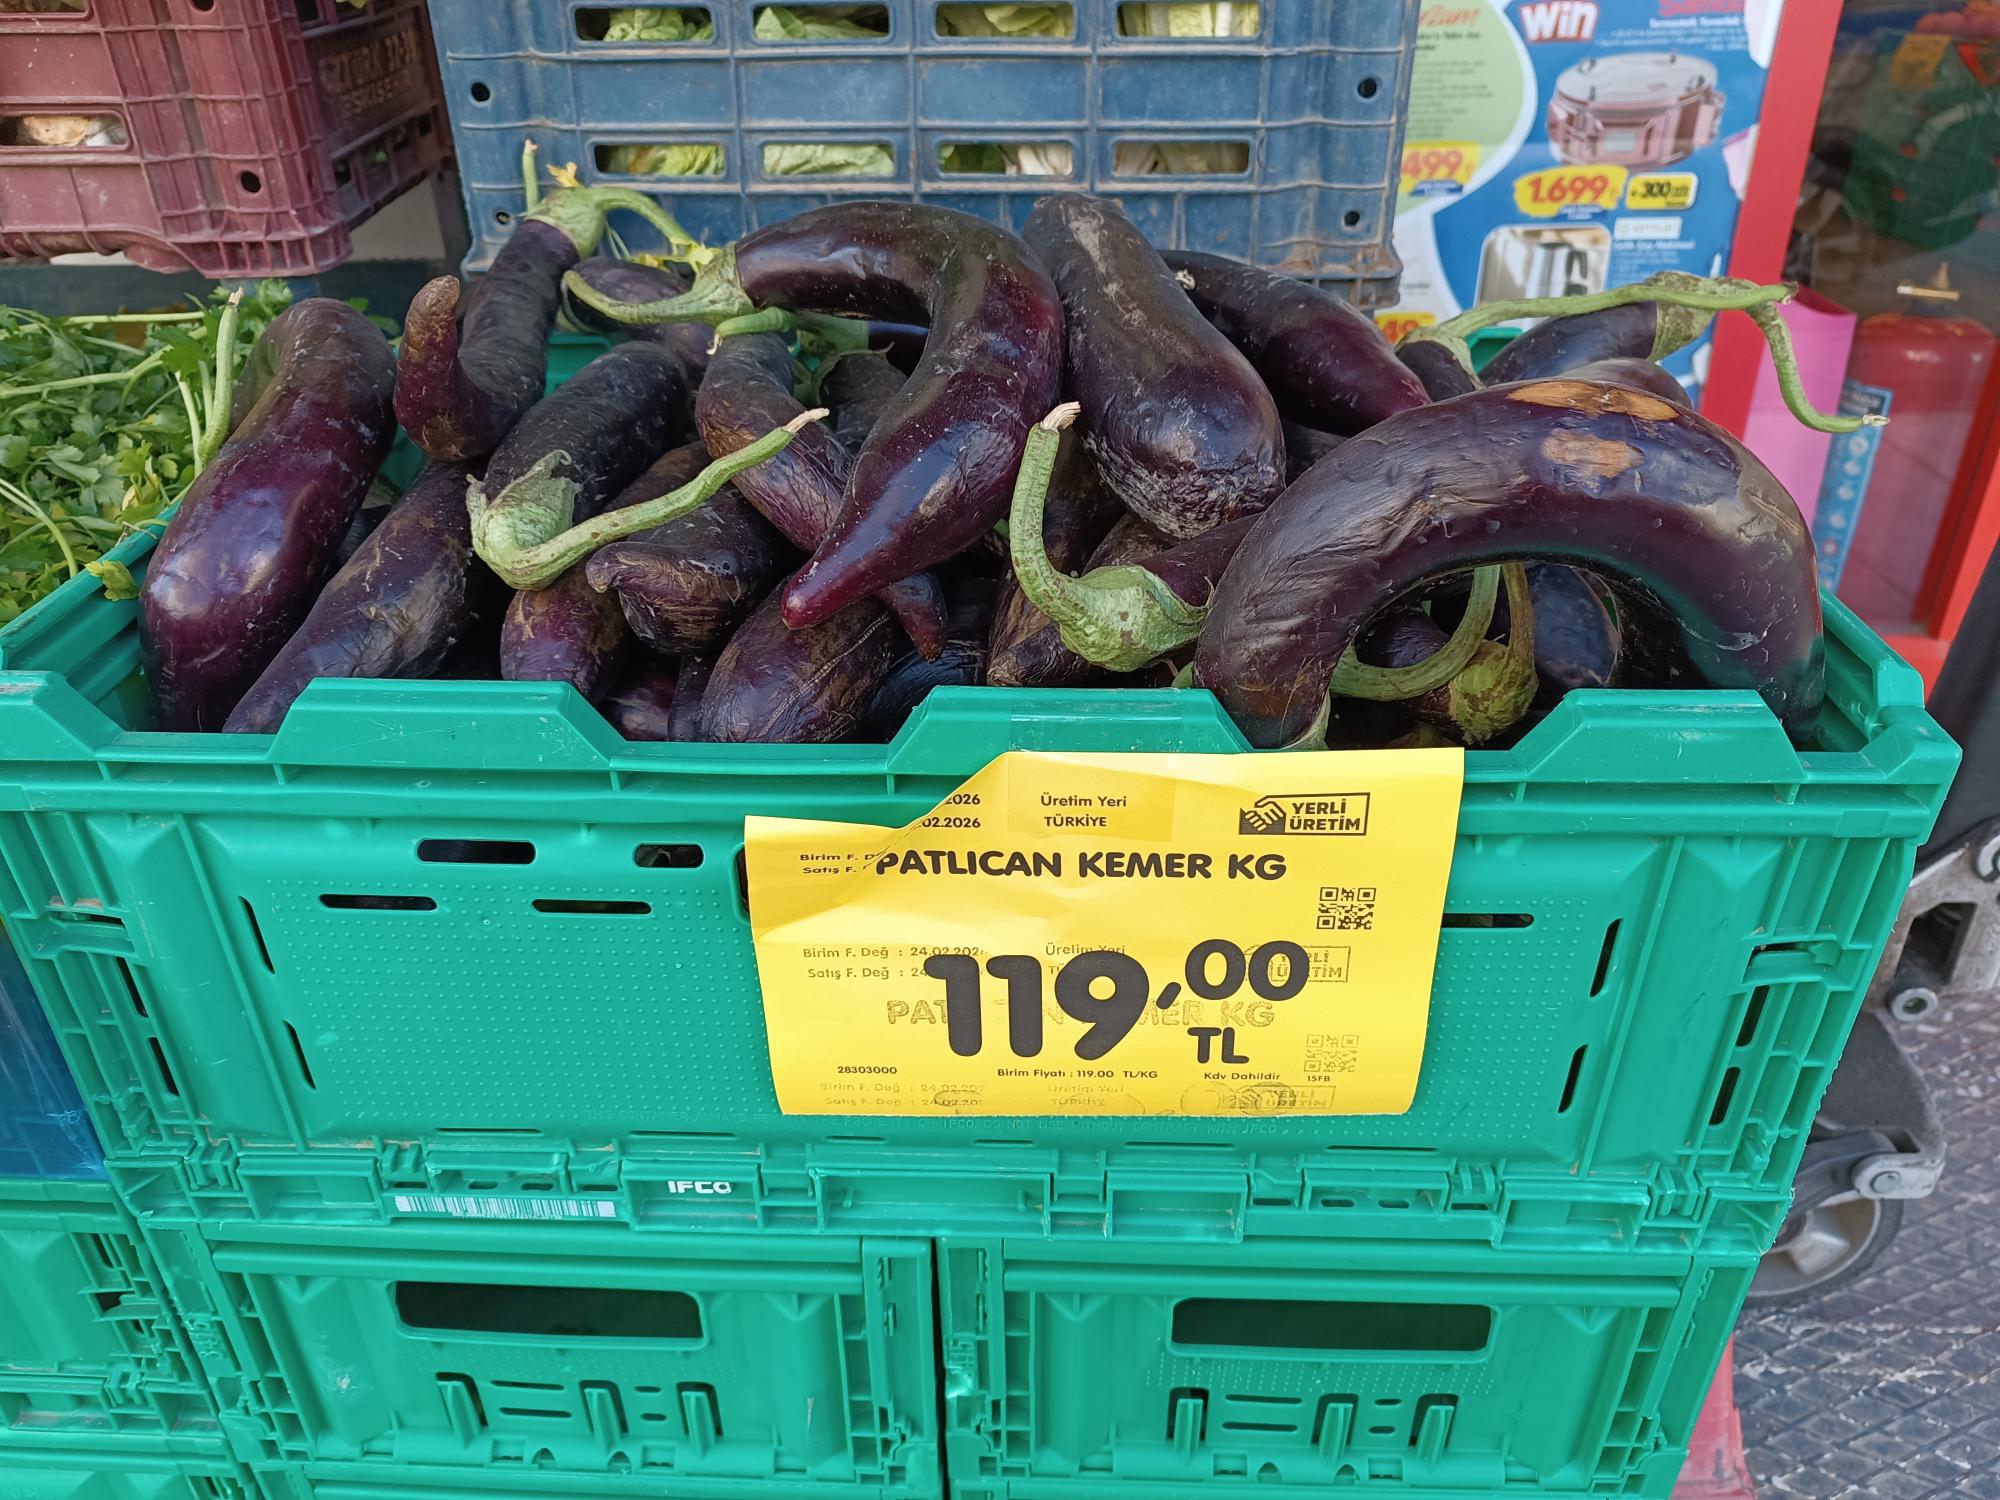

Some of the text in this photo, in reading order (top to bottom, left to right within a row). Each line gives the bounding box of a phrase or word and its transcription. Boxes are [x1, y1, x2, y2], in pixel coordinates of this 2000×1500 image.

[1529, 175, 1609, 204] 1.699
[1040, 793, 1092, 808] Üretim
[1097, 795, 1127, 808] Yeri
[1291, 798, 1347, 815] YERLİ
[1044, 813, 1107, 827] TÜRKİYE
[1290, 815, 1360, 831] ÜRETİM
[800, 853, 841, 861] Birim
[847, 853, 858, 861] F.
[803, 866, 840, 875] Satış
[876, 850, 1287, 880] PATLICAN KEMER KG
[803, 947, 840, 958] Birim
[846, 947, 857, 958] F.
[861, 946, 889, 959] Değ
[910, 946, 989, 957] 24.02.202
[807, 967, 841, 980] Satış
[846, 968, 857, 978] F.
[862, 966, 890, 980] Değ
[1221, 1000, 1275, 1027] KG
[1187, 1027, 1250, 1064] TL
[838, 1066, 897, 1074] 28303000
[997, 1068, 1029, 1077] Birim
[1034, 1069, 1066, 1079] Fiyatı
[1077, 1070, 1114, 1078] 119.00
[1123, 1070, 1158, 1078] TL/KG
[1204, 1072, 1227, 1080] Kdv
[1232, 1072, 1281, 1080] Dahildir
[668, 1180, 732, 1193] IFCO
